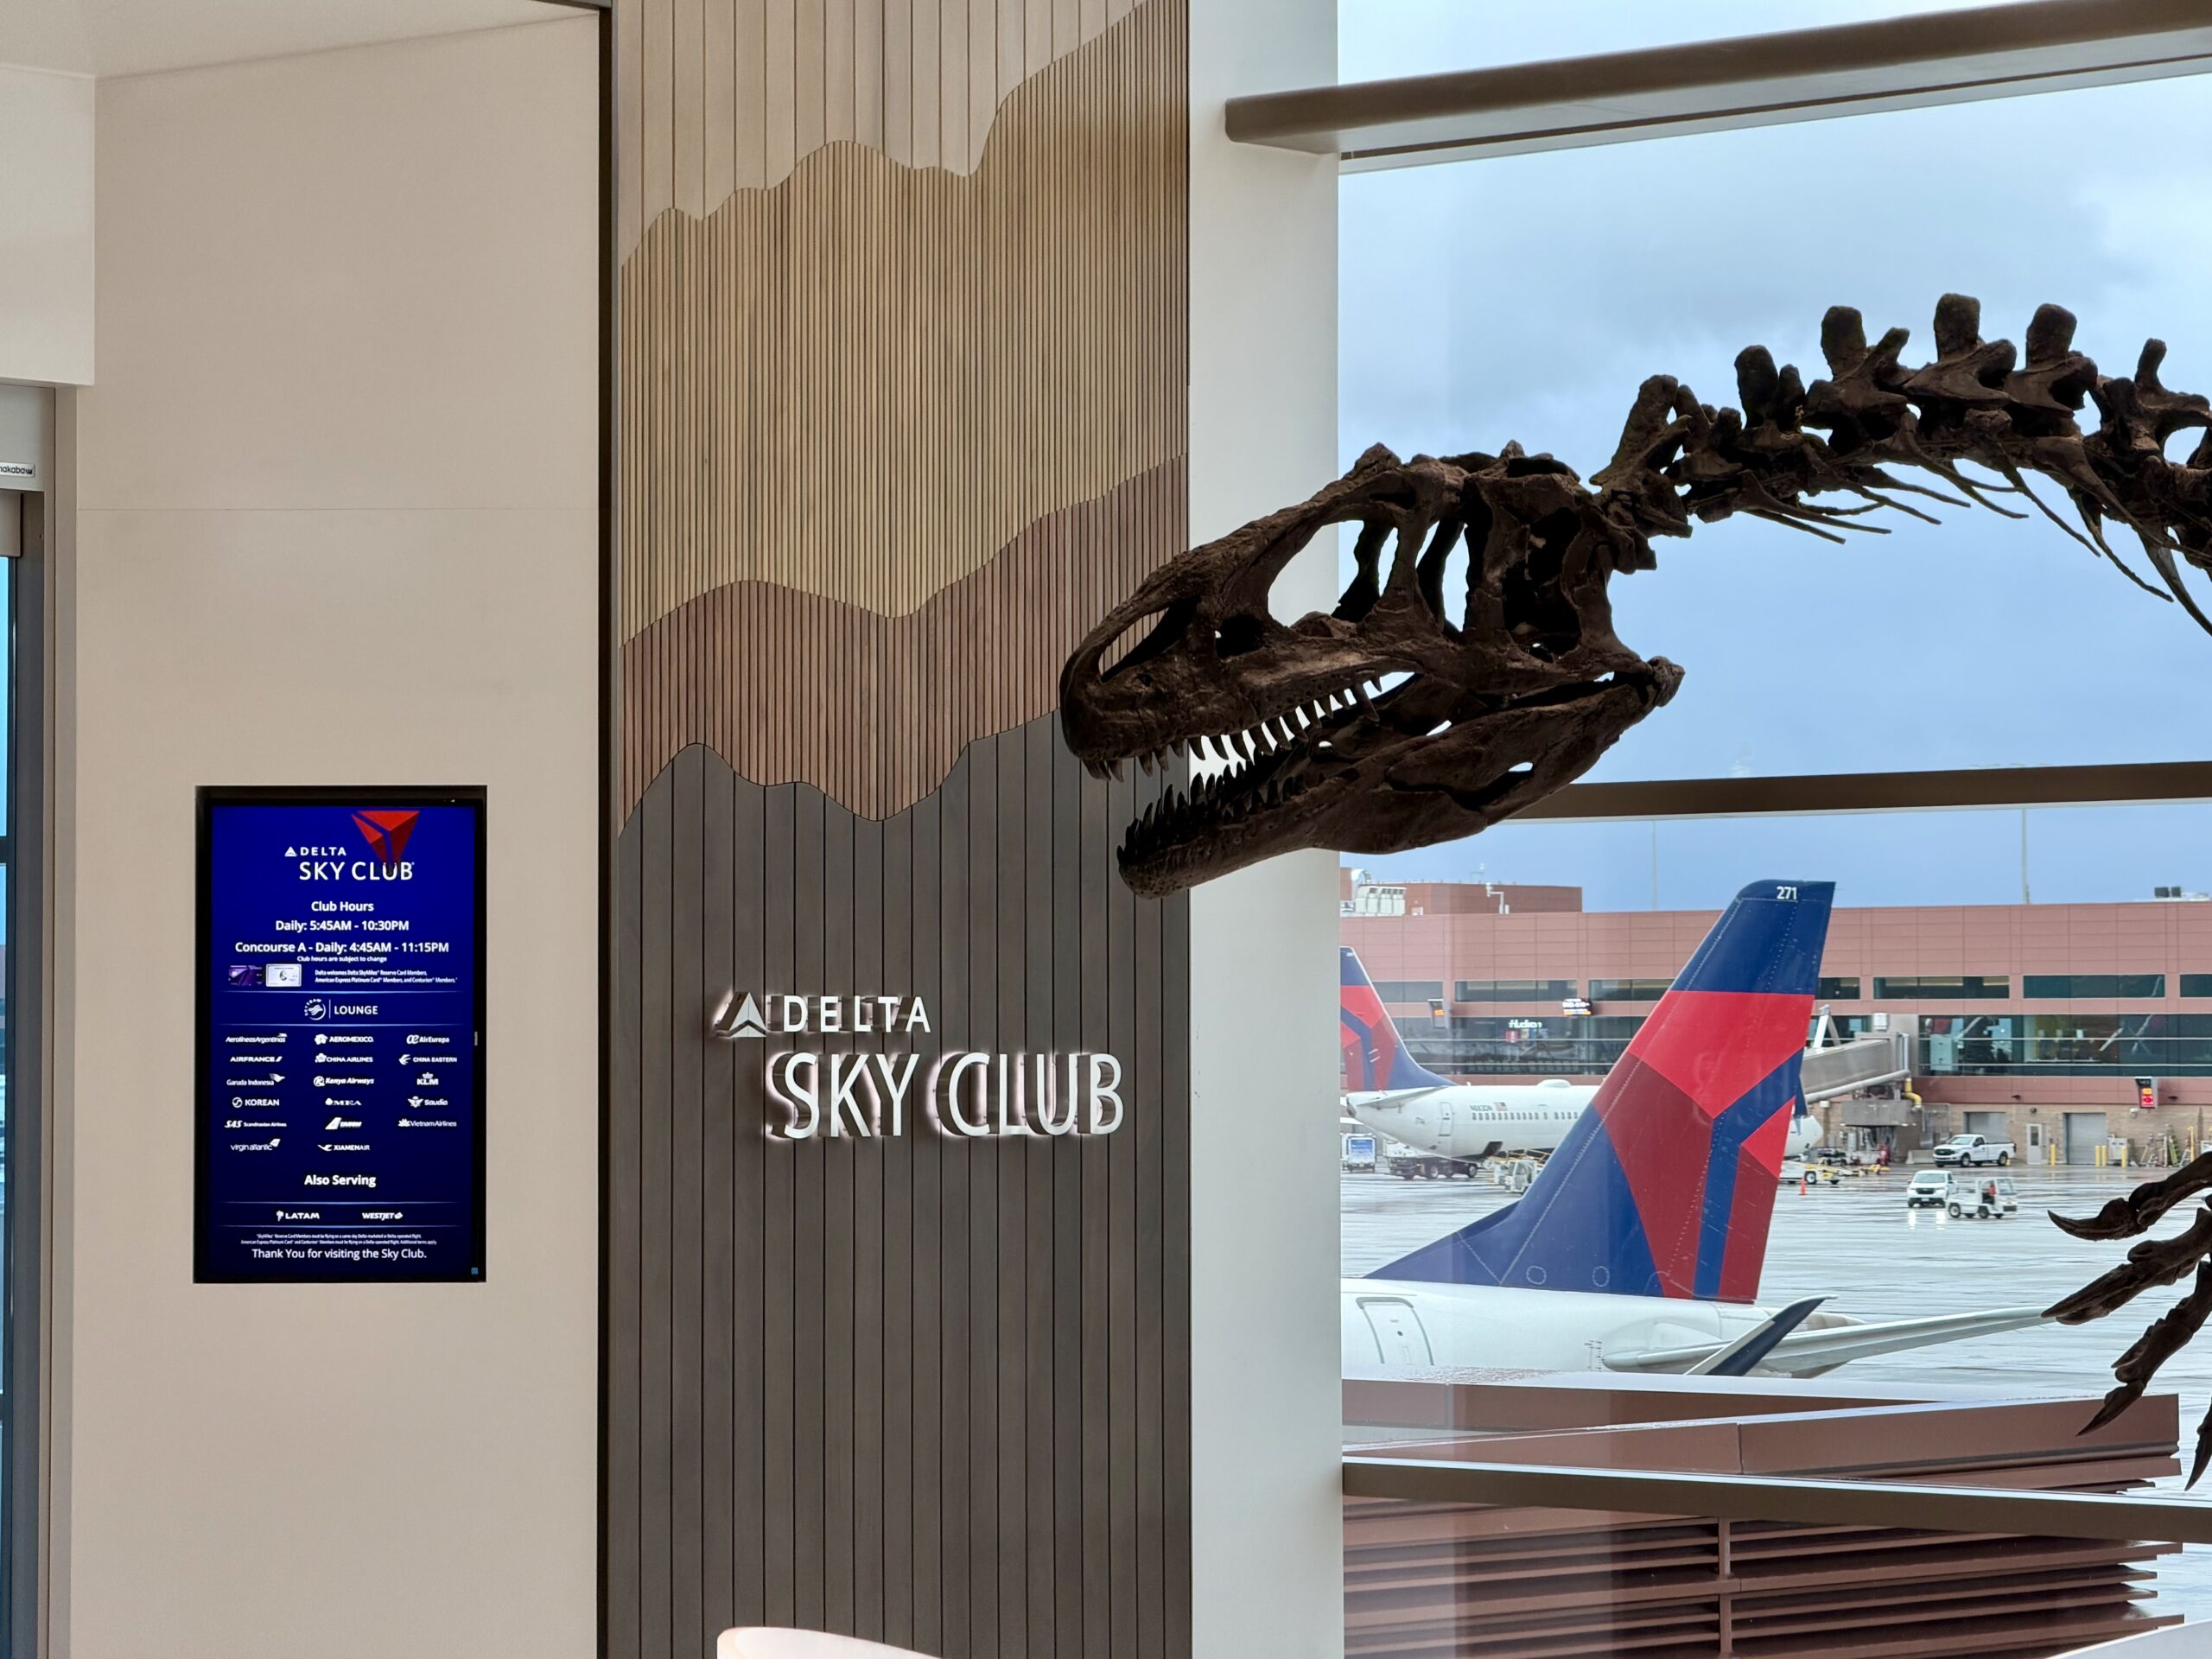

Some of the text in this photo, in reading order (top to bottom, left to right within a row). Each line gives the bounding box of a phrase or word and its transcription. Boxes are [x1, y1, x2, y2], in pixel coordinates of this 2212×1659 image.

[300, 847, 347, 856] DELTA
[299, 861, 346, 880] SKY
[1776, 886, 1798, 900] 271
[311, 901, 374, 912] Club Hours
[276, 920, 308, 933] Daily:
[309, 920, 352, 931] 5:45AM
[361, 920, 410, 931] 10:30PM
[235, 942, 296, 953] Concourse
[297, 942, 307, 953] A
[315, 942, 347, 955] Daily:
[349, 942, 392, 953] 4:45AM
[401, 942, 449, 953] 11:15PM
[339, 957, 359, 965] subject
[367, 957, 388, 965] change
[334, 1005, 378, 1015] LOUNGE
[782, 996, 931, 1033] DELTA
[778, 1052, 1125, 1139] SKY CLUB
[245, 1098, 280, 1107] KOREAN
[225, 1120, 243, 1128] SAS
[304, 1174, 377, 1188] Also Serving
[362, 1212, 395, 1221] WESTJET
[251, 1249, 428, 1262] Thank You for visiting the Sky Club.
